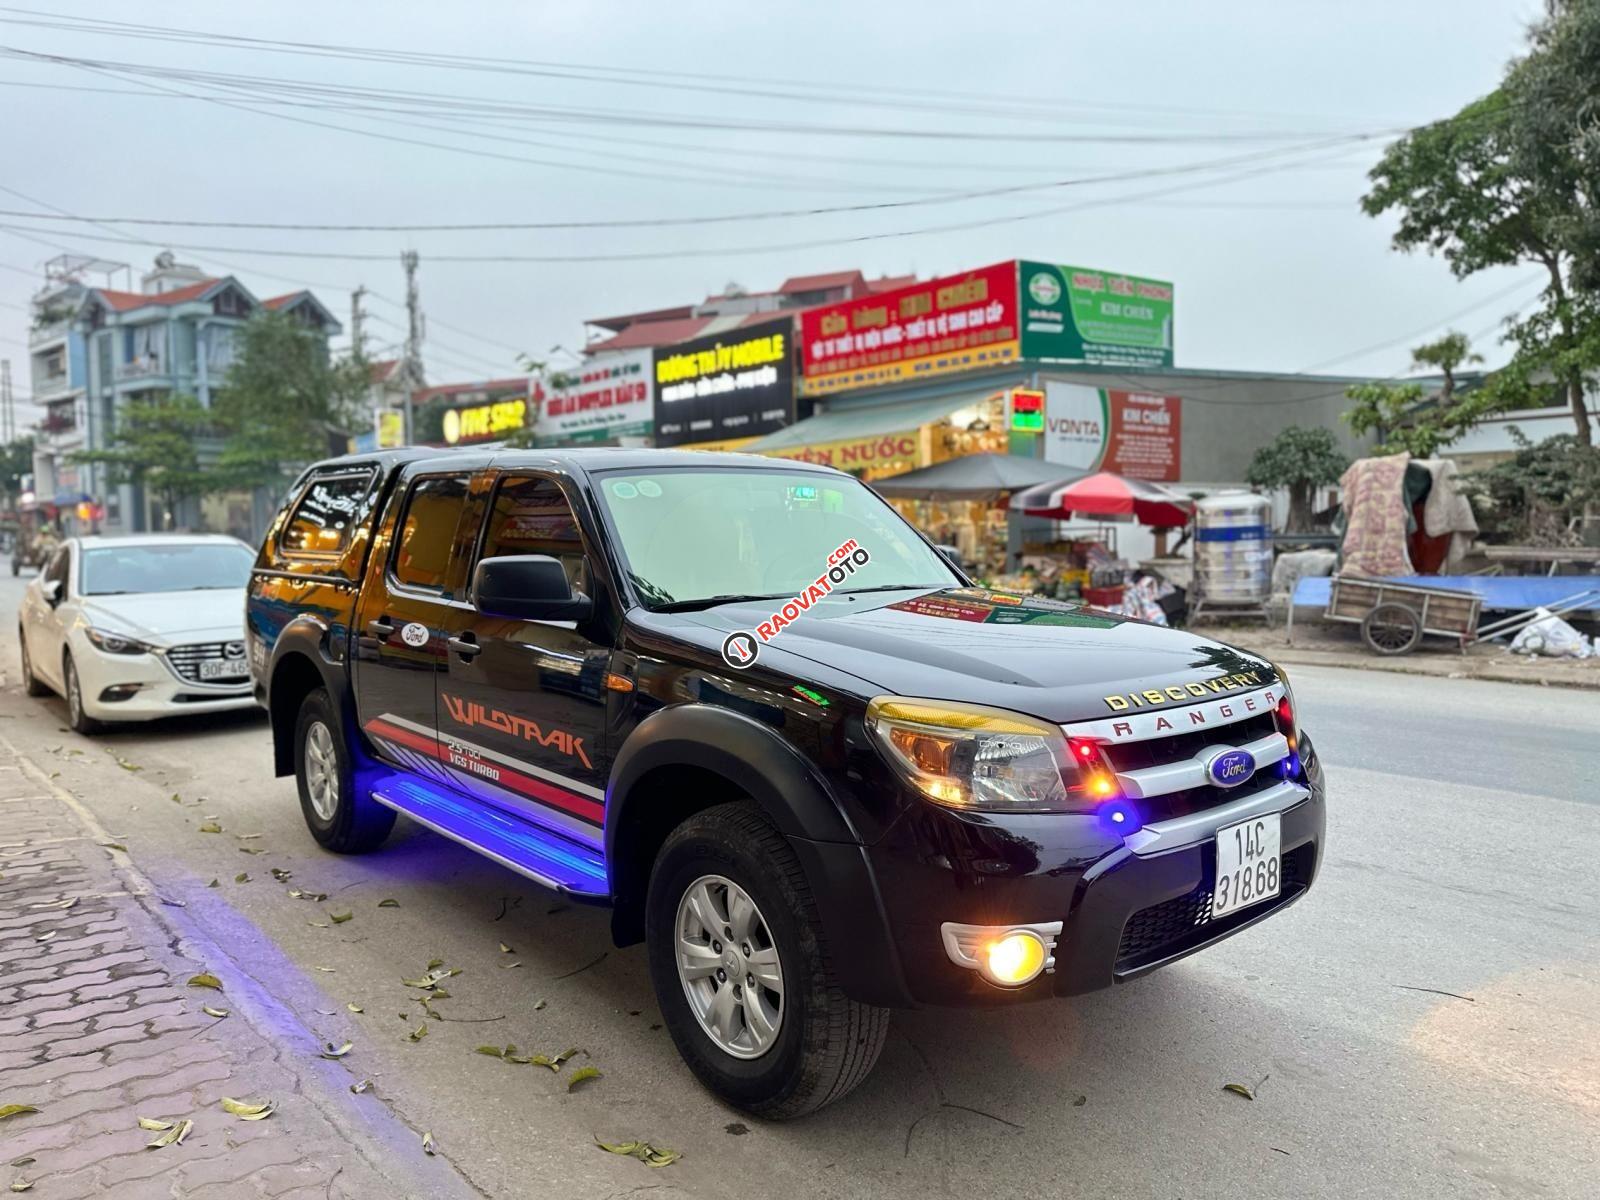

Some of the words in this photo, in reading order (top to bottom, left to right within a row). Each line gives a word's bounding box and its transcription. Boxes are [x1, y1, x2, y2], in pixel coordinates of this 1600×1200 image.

[1049, 418, 1100, 436] VONTA
[841, 435, 915, 464] NƯỚC
[1104, 672, 1261, 711] DISCOVERY
[442, 693, 592, 770] WILDTRAK
[1113, 692, 1278, 736] RANGER
[469, 759, 500, 781] TURBO
[1222, 756, 1247, 778] Ford
[1236, 822, 1264, 865] 14C
[1216, 857, 1278, 910] 318.68
